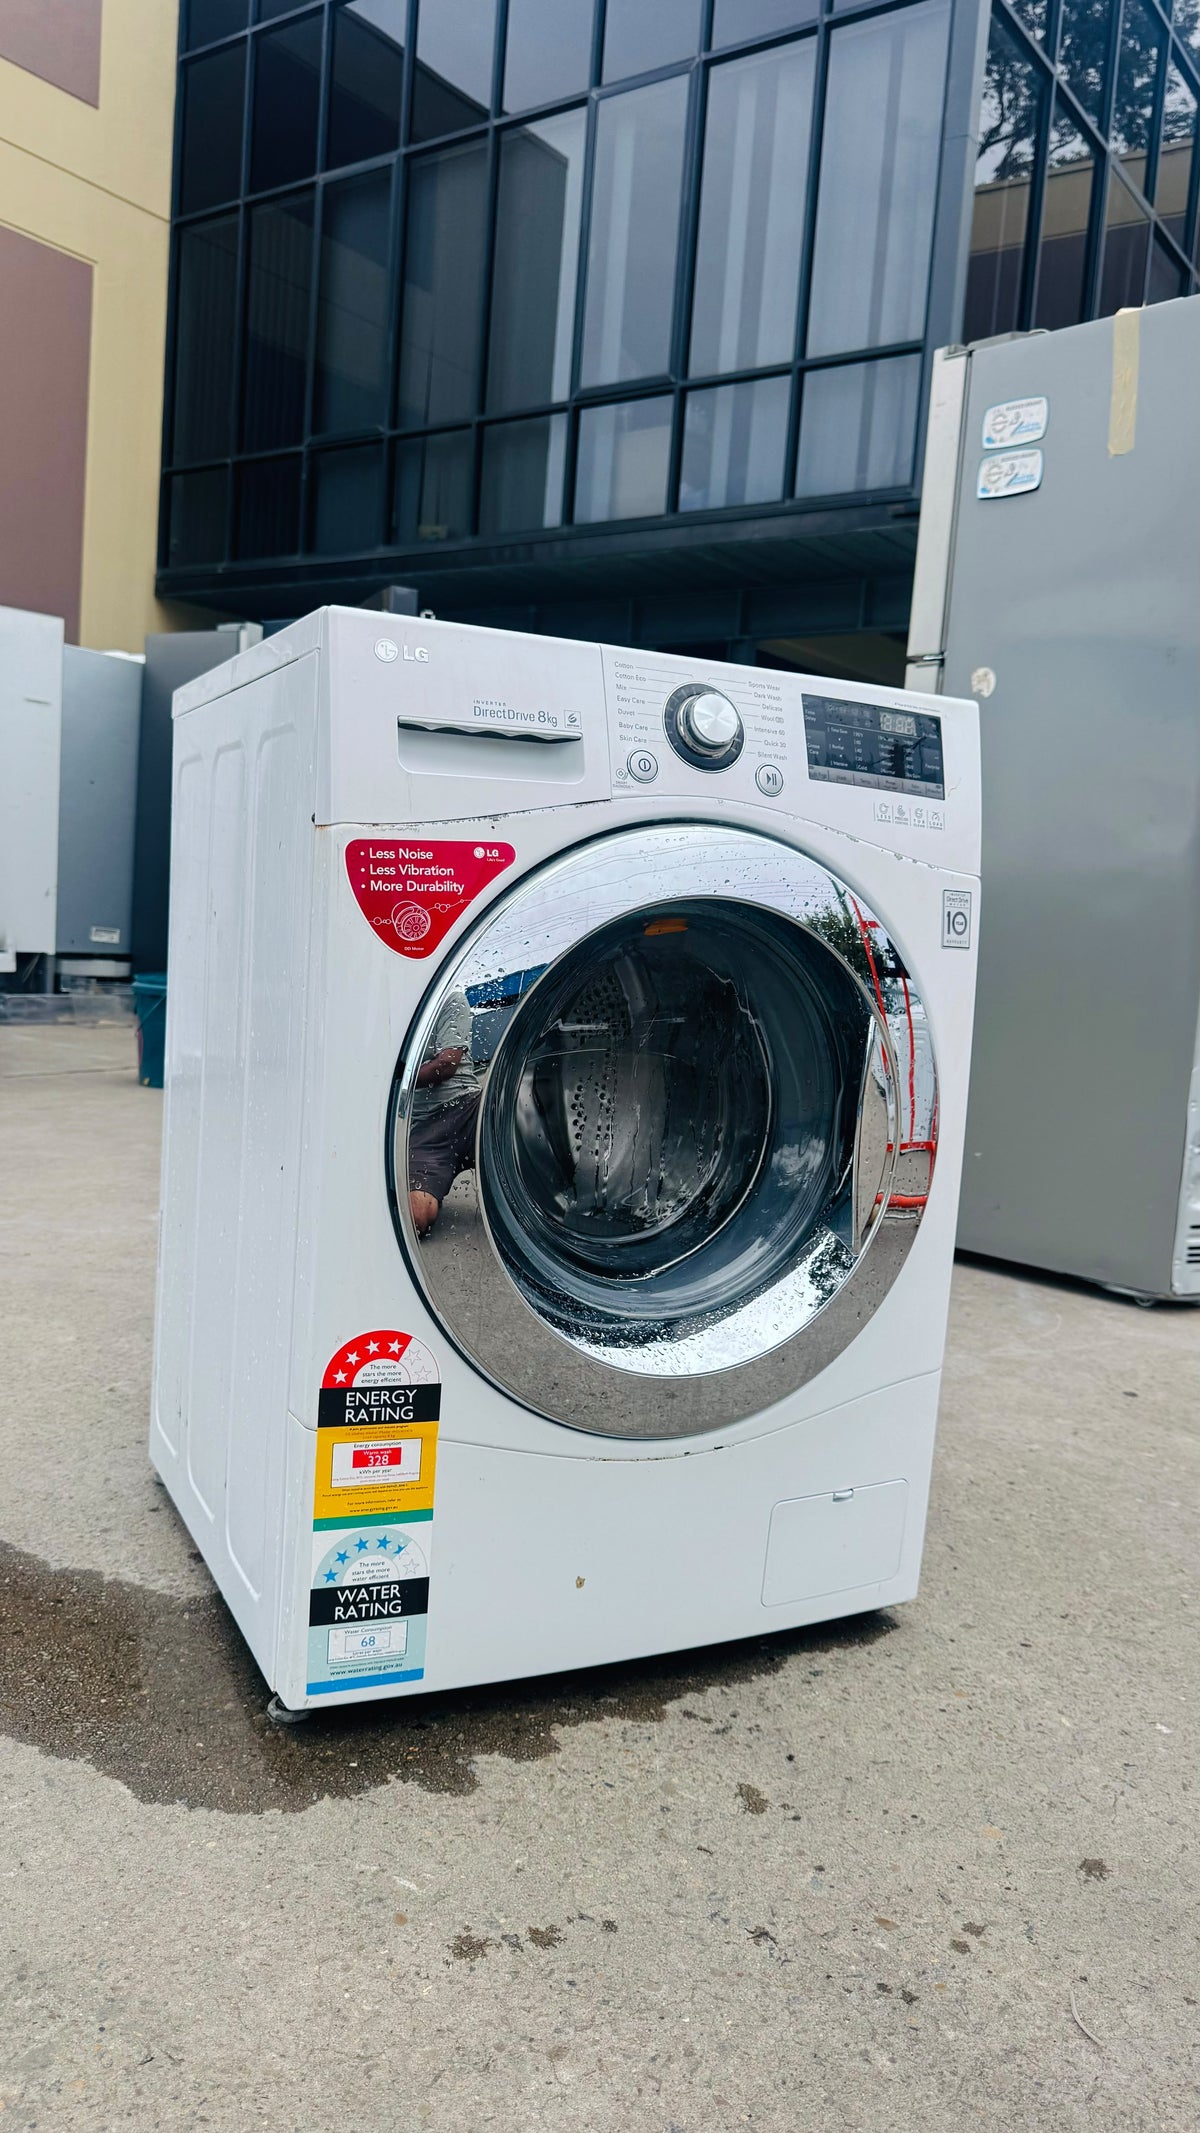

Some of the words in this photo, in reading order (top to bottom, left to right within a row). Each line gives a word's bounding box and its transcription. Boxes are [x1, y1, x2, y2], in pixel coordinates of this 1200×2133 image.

[403, 645, 429, 663] LG
[615, 672, 634, 680] Cotton
[616, 695, 631, 703] Easy
[762, 703, 782, 712] Delicate
[538, 711, 558, 727] 8kg
[618, 722, 634, 730] Baby
[773, 753, 787, 761] Wash
[369, 848, 395, 859] Less
[399, 848, 433, 860] Noise
[370, 864, 396, 875] Less
[399, 864, 454, 876] Vibration
[370, 881, 403, 891] More
[407, 881, 464, 895] Durability
[947, 911, 967, 936] 10
[346, 1389, 417, 1406] ENERGY
[345, 1406, 414, 1423] RATING
[367, 1455, 389, 1466] 328
[337, 1584, 400, 1603] WATER
[335, 1600, 402, 1620] RATING
[361, 1636, 376, 1647] 68
[330, 1663, 402, 1676] www.waterrating.gov.au
